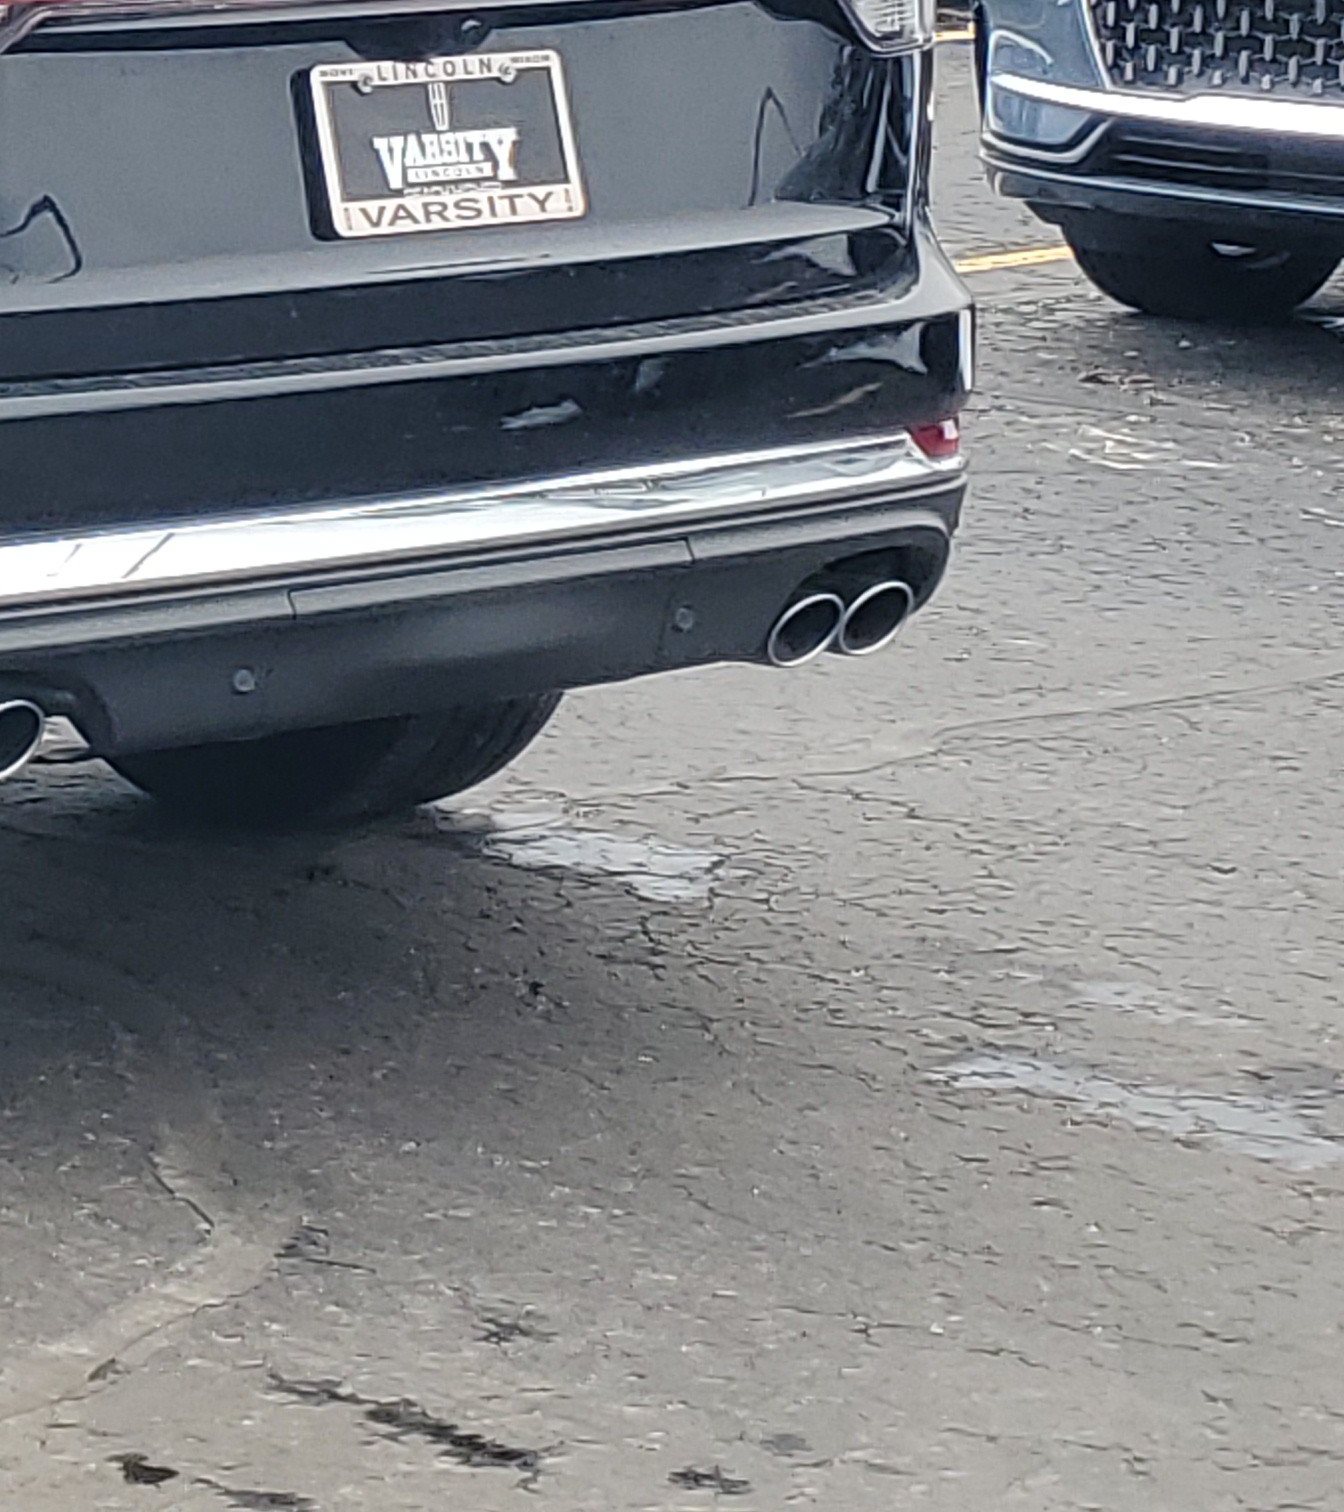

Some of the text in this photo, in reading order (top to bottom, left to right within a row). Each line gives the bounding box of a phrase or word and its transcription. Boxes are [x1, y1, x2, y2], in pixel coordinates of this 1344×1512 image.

[376, 56, 494, 82] LINCOLN
[372, 127, 518, 190] VARSITY
[414, 165, 485, 179] LINCOLN
[358, 191, 555, 229] VARSITY
